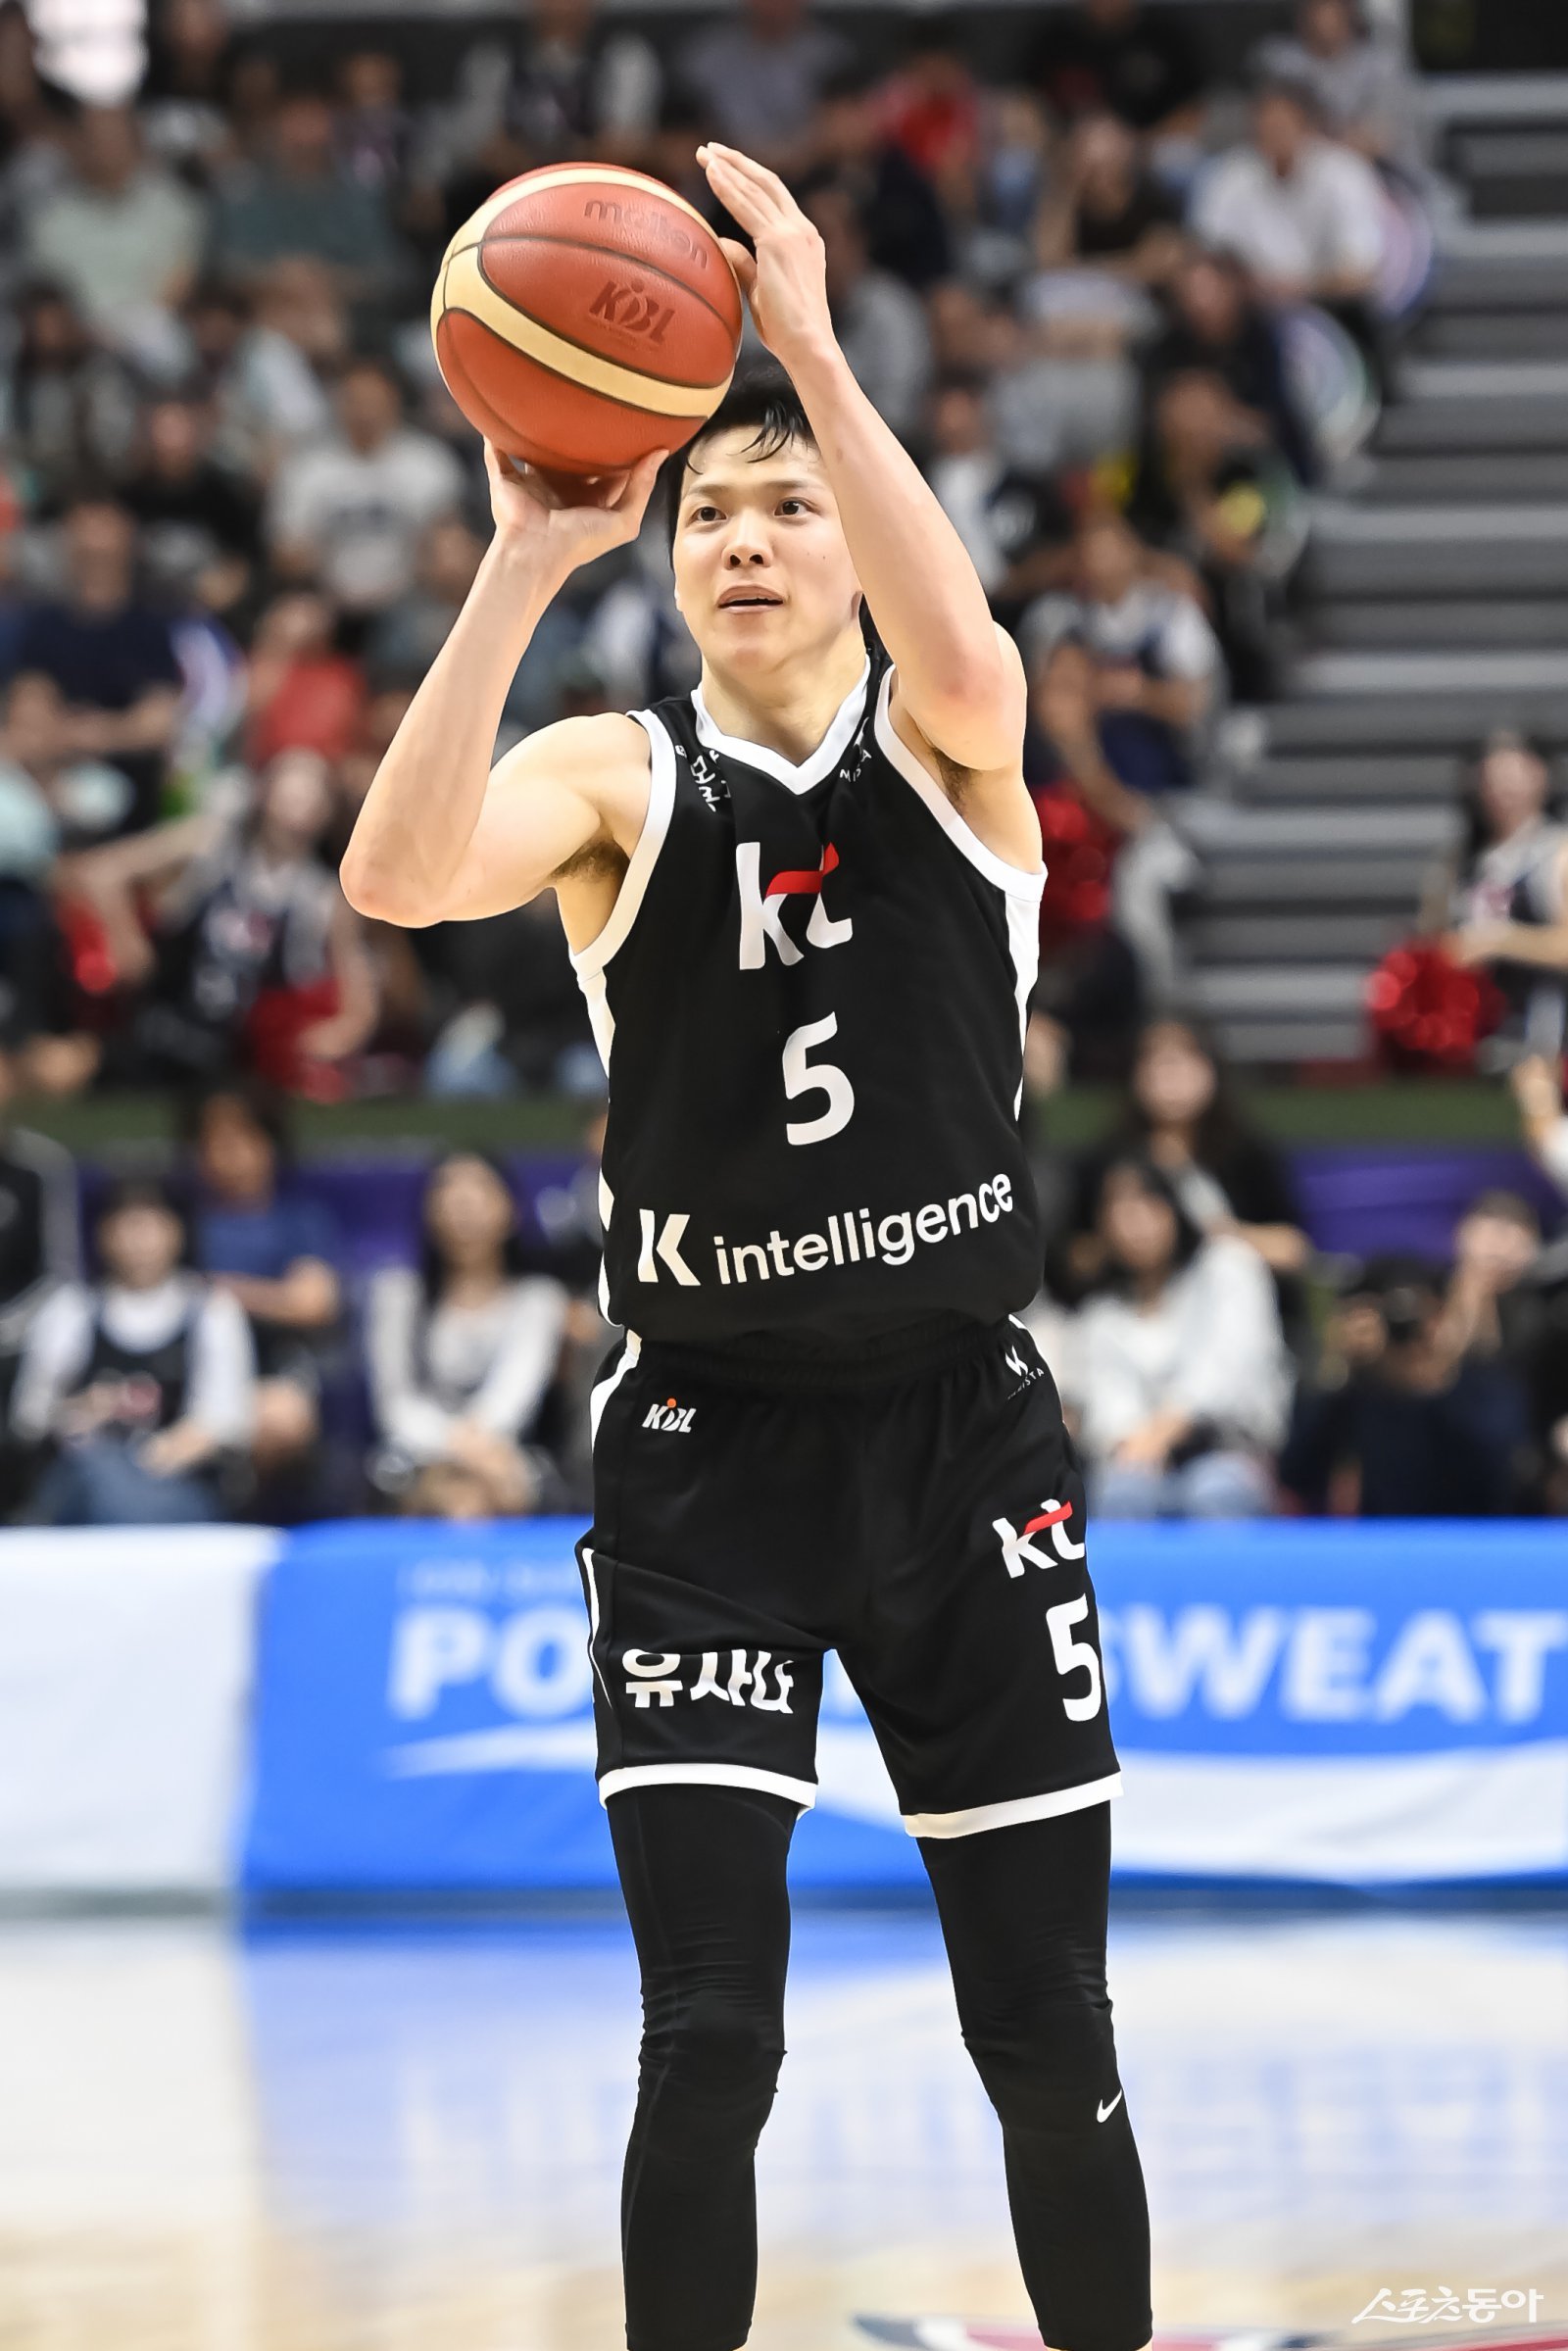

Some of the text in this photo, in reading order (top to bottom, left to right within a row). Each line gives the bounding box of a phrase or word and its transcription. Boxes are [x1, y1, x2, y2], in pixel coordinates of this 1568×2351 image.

[584, 200, 708, 269] molten
[589, 280, 676, 343] KBL
[736, 841, 854, 970] kt
[782, 1011, 856, 1147] 5
[637, 1173, 1013, 1286] K intelligence
[641, 1397, 697, 1433] KBL
[992, 1498, 1086, 1579] kt
[621, 1648, 795, 1714] 유사나
[1046, 1593, 1102, 1723] 5
[1098, 1603, 1567, 1723] WEAT
